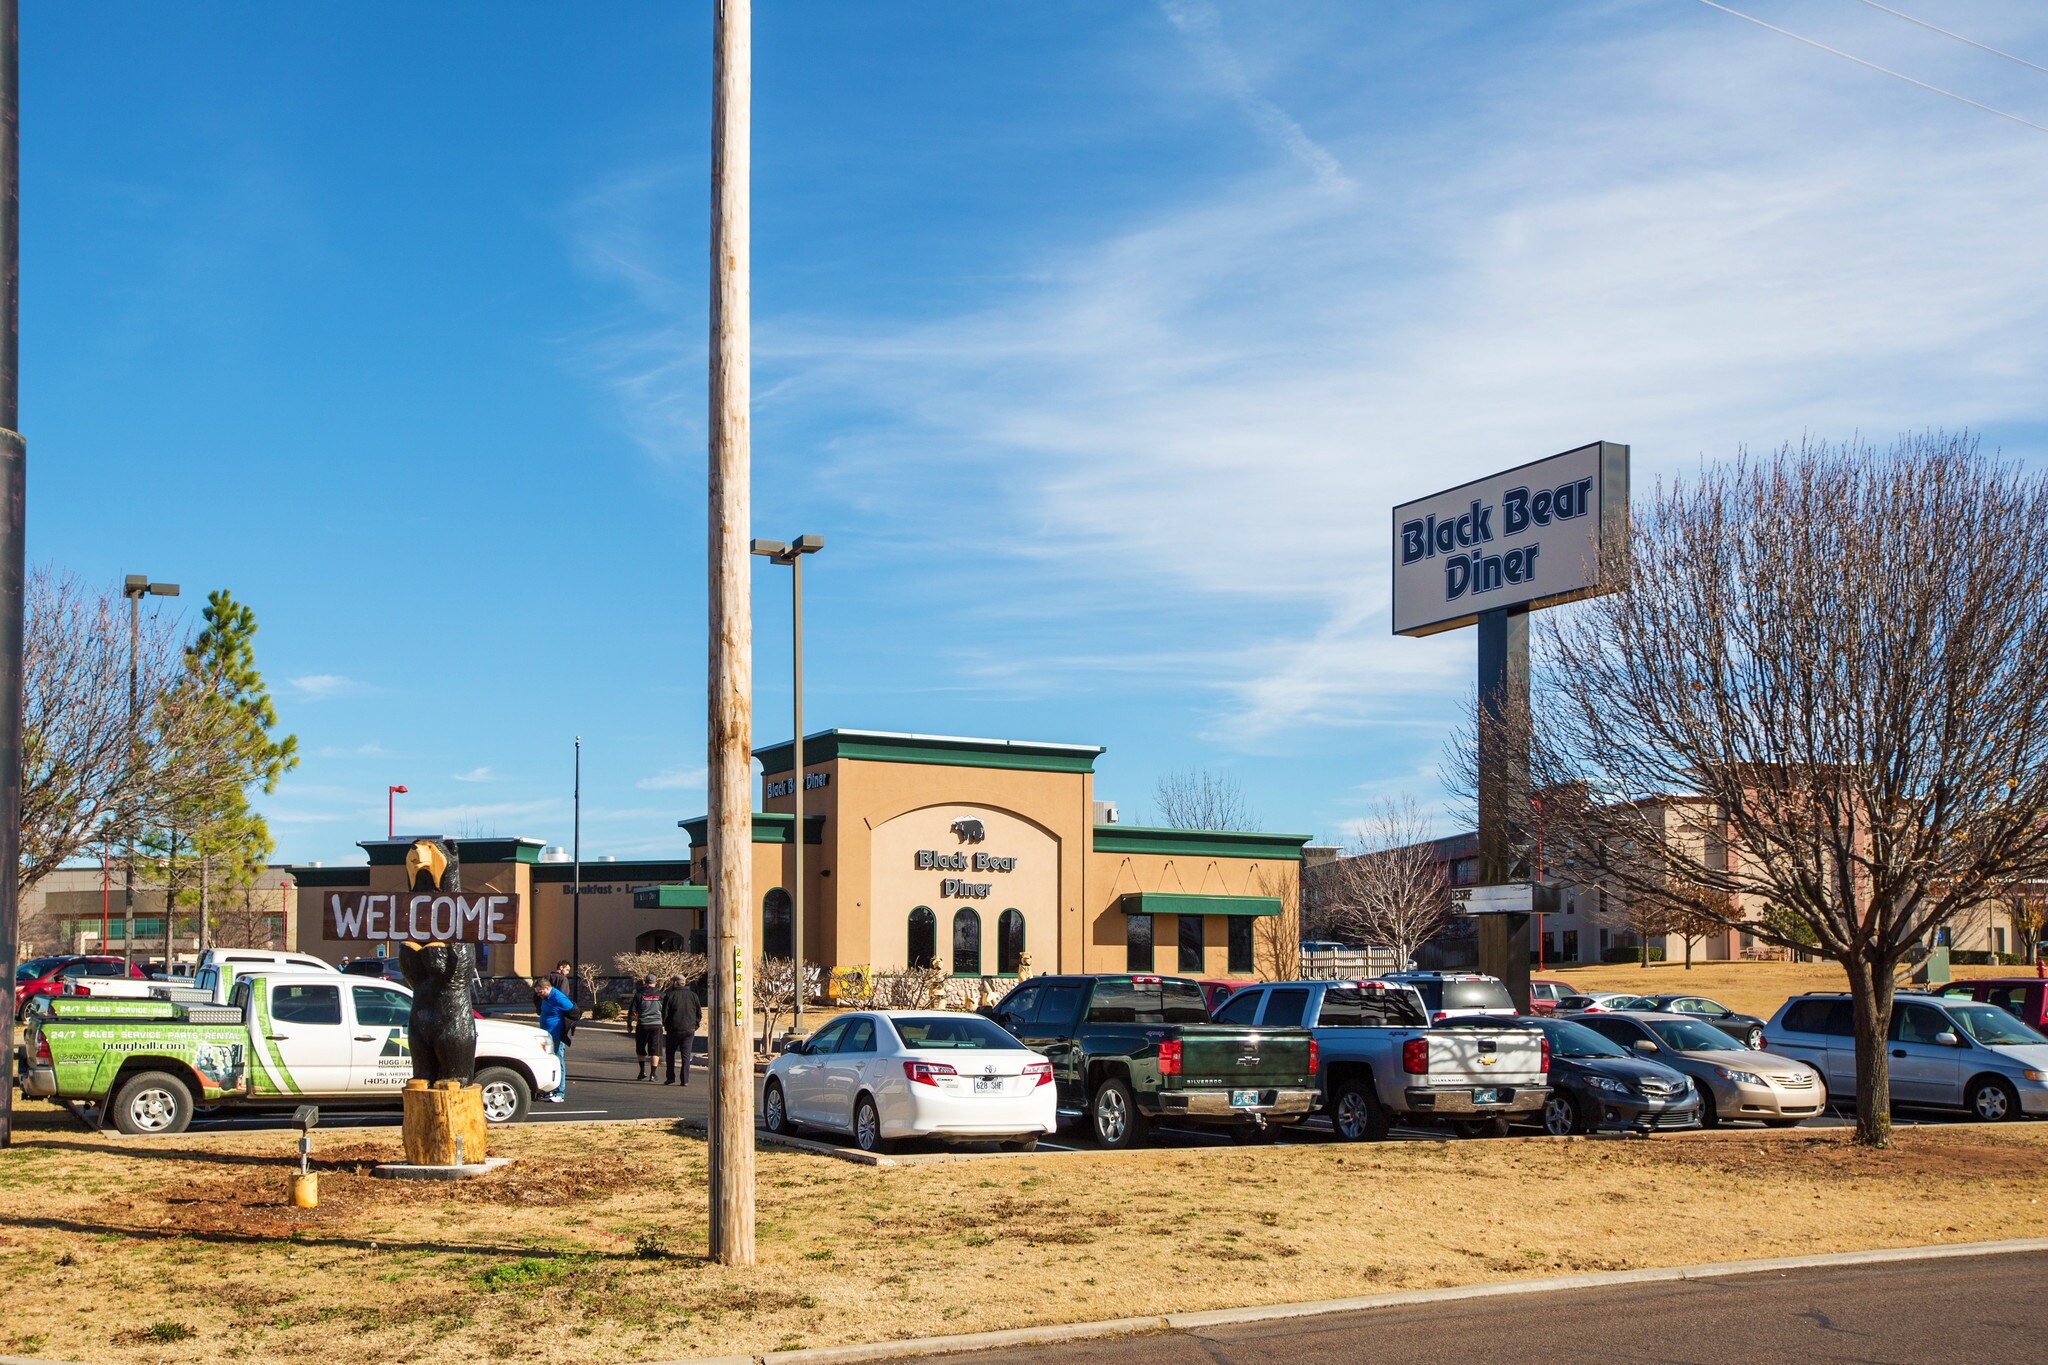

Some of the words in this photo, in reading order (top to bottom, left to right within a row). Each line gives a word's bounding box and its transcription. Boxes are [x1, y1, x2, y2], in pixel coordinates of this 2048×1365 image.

[1400, 499, 1494, 566] Black
[1502, 476, 1593, 537] Bear
[1444, 543, 1540, 602] Diner
[767, 780, 787, 799] Black
[806, 773, 827, 790] Diner
[917, 850, 969, 871] Black
[974, 852, 1018, 872] Bear
[562, 884, 613, 895] Brakfast
[943, 878, 993, 898] Diner
[331, 893, 509, 942] WELCOME
[60, 1005, 80, 1013] 24/7
[85, 1005, 111, 1013] SALES
[115, 1006, 148, 1014] SERVICE
[51, 1031, 76, 1039] 24/7
[83, 1031, 114, 1039] SALES
[120, 1031, 161, 1039] SERVICE
[167, 1031, 198, 1040] PARTS
[204, 1031, 240, 1040] RENTAL
[976, 1081, 988, 1090] 628
